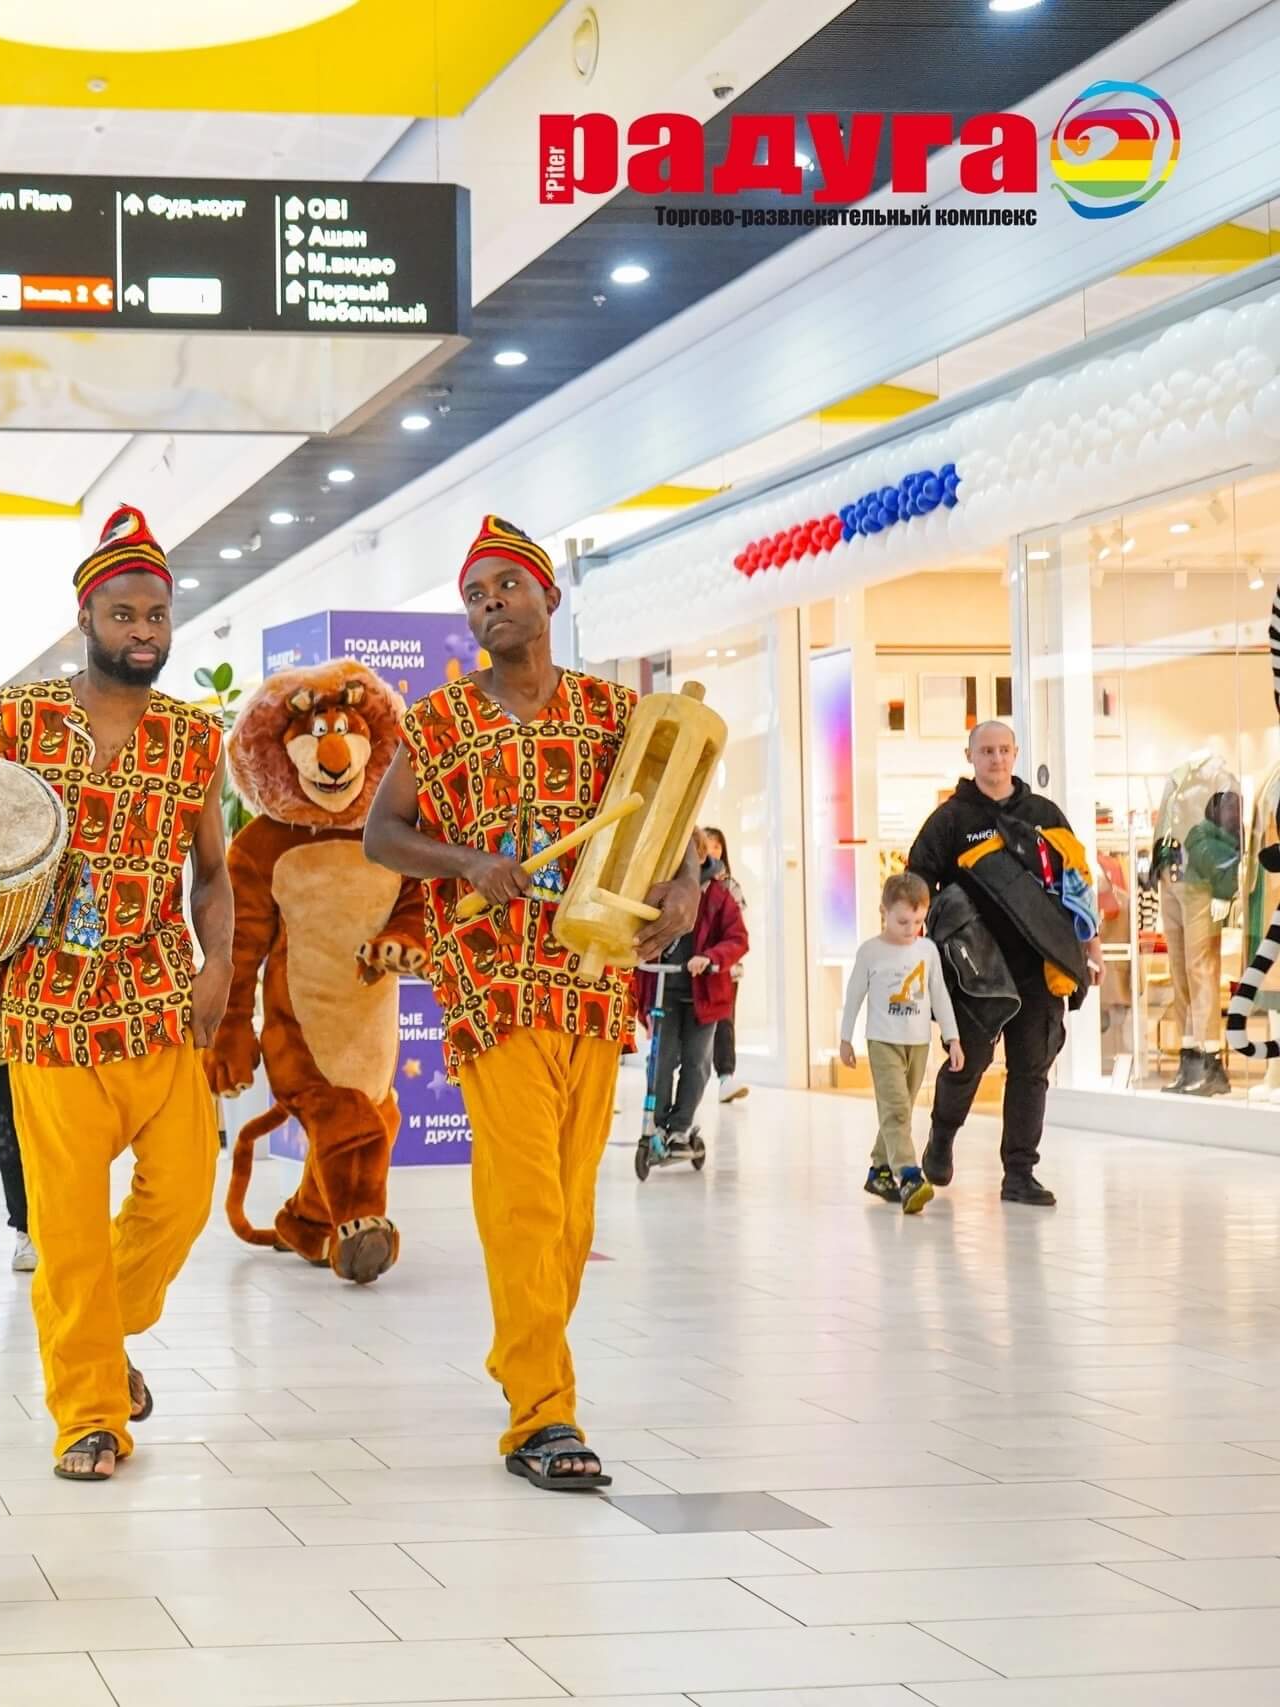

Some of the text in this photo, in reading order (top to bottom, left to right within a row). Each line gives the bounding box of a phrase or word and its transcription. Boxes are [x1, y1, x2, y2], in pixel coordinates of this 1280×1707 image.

[147, 194, 246, 221] Фуд-корт
[307, 198, 348, 220] OBI
[308, 225, 367, 247] Ашан
[307, 252, 396, 277] М.видео
[308, 279, 389, 304] Первый
[308, 301, 427, 324] Мебельный
[344, 638, 421, 653] ПОДАРКИ
[360, 654, 425, 670] СКИДКИ
[409, 1115, 421, 1129] И
